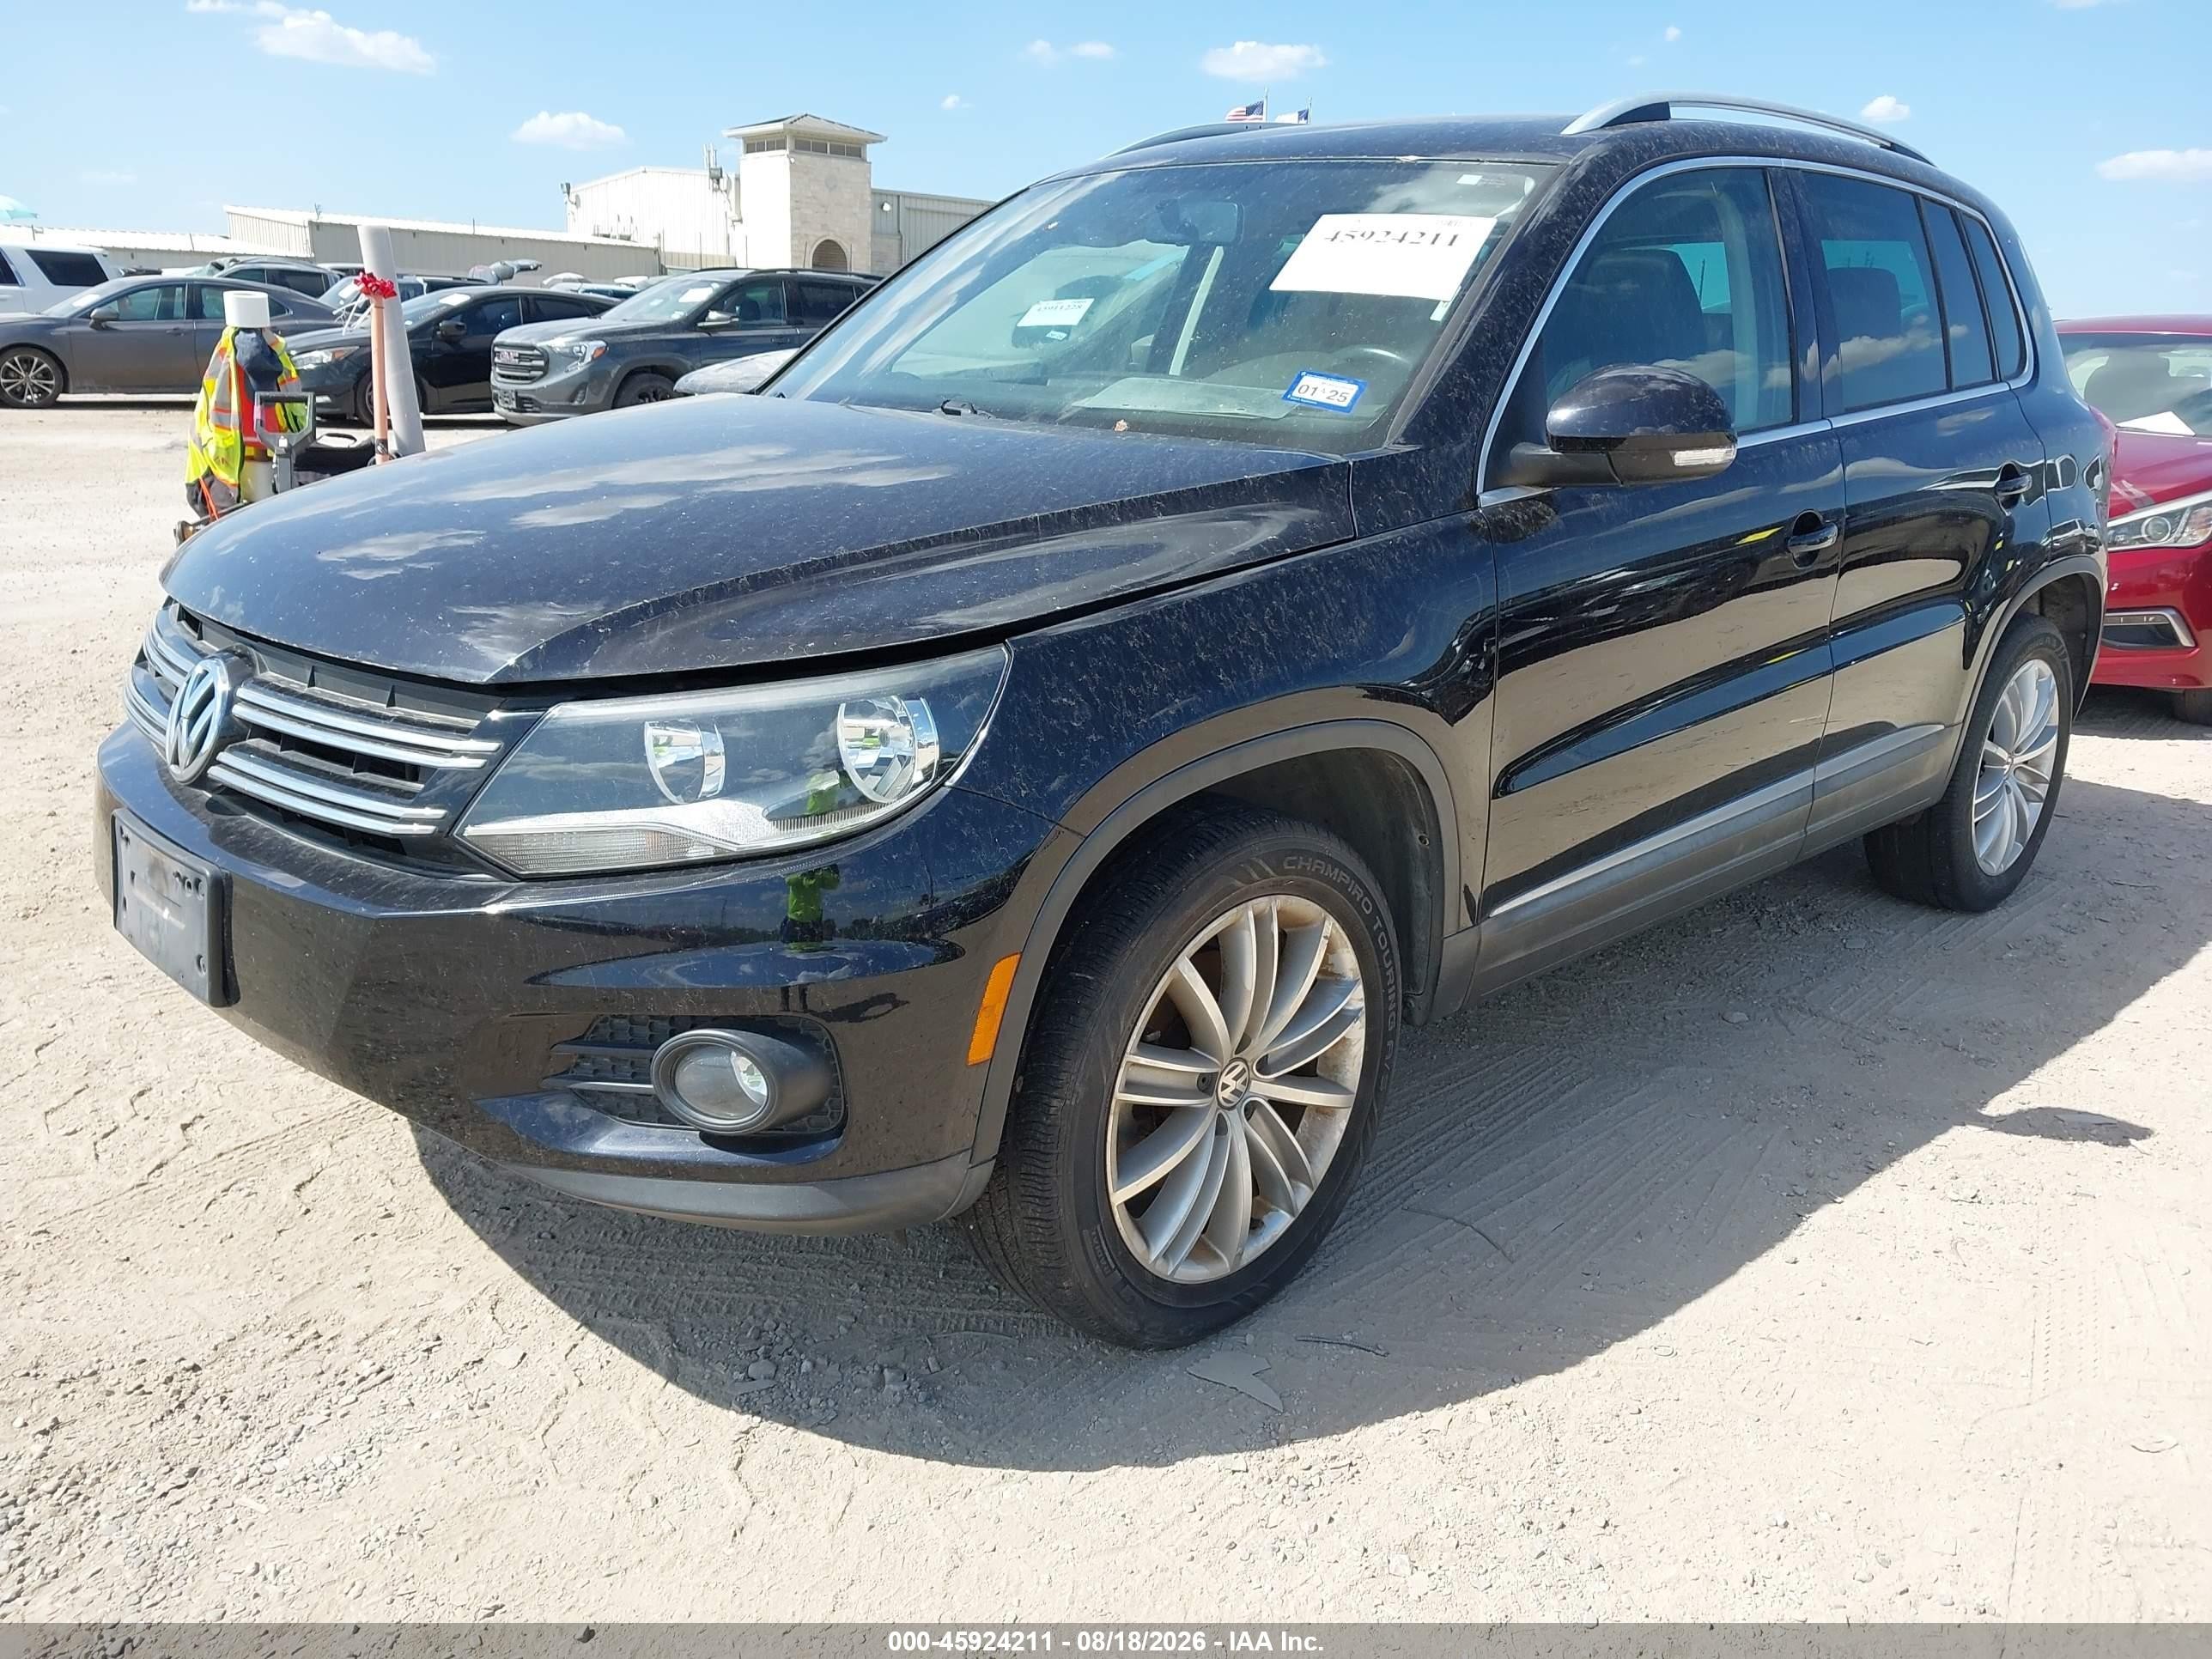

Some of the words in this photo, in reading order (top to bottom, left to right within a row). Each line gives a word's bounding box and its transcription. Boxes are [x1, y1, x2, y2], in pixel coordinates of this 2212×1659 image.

[1325, 230, 1459, 247] 45924211
[1297, 384, 1318, 397] 01
[1326, 390, 1350, 403] 25
[1283, 856, 1372, 915] CHAMPIRO
[1373, 915, 1396, 1031] TOURING
